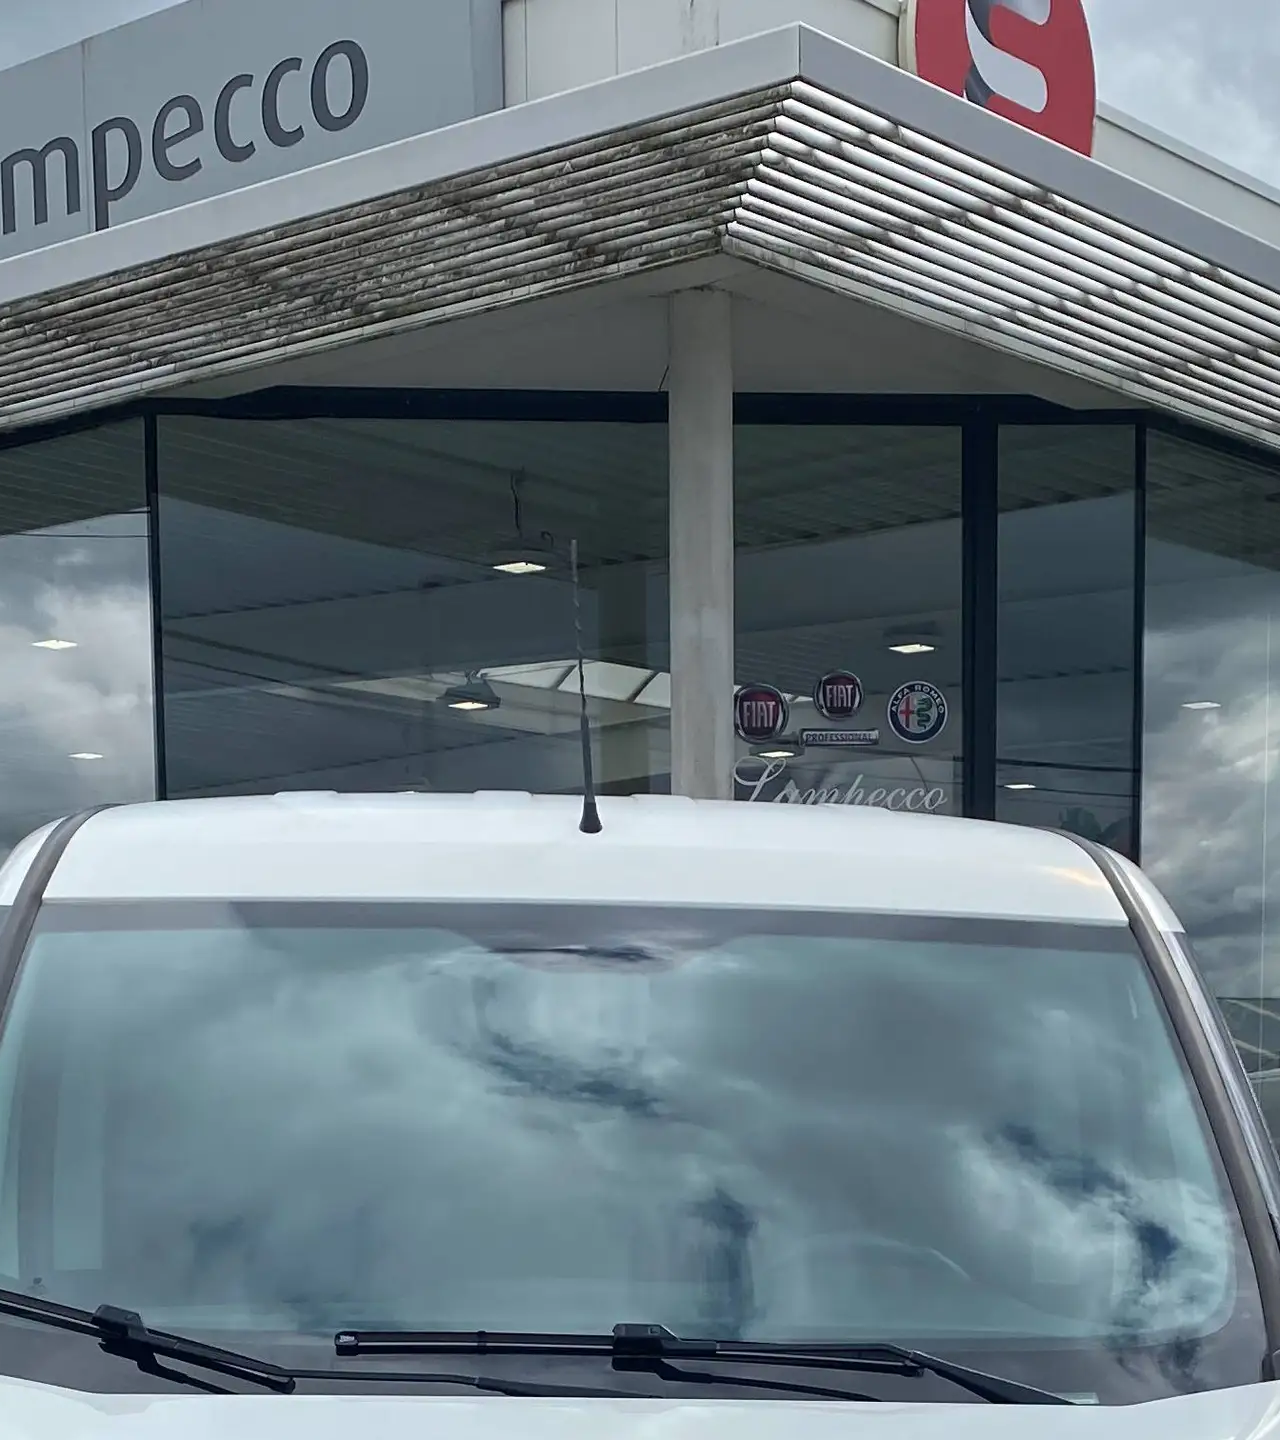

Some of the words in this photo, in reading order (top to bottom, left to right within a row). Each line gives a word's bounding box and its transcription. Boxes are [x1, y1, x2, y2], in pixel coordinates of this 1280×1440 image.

[826, 685, 854, 707] FIAT
[891, 687, 910, 713] ALFA
[914, 684, 945, 714] ROMEO
[743, 701, 776, 728] FIAT
[805, 732, 873, 742] PROFESSIONAL
